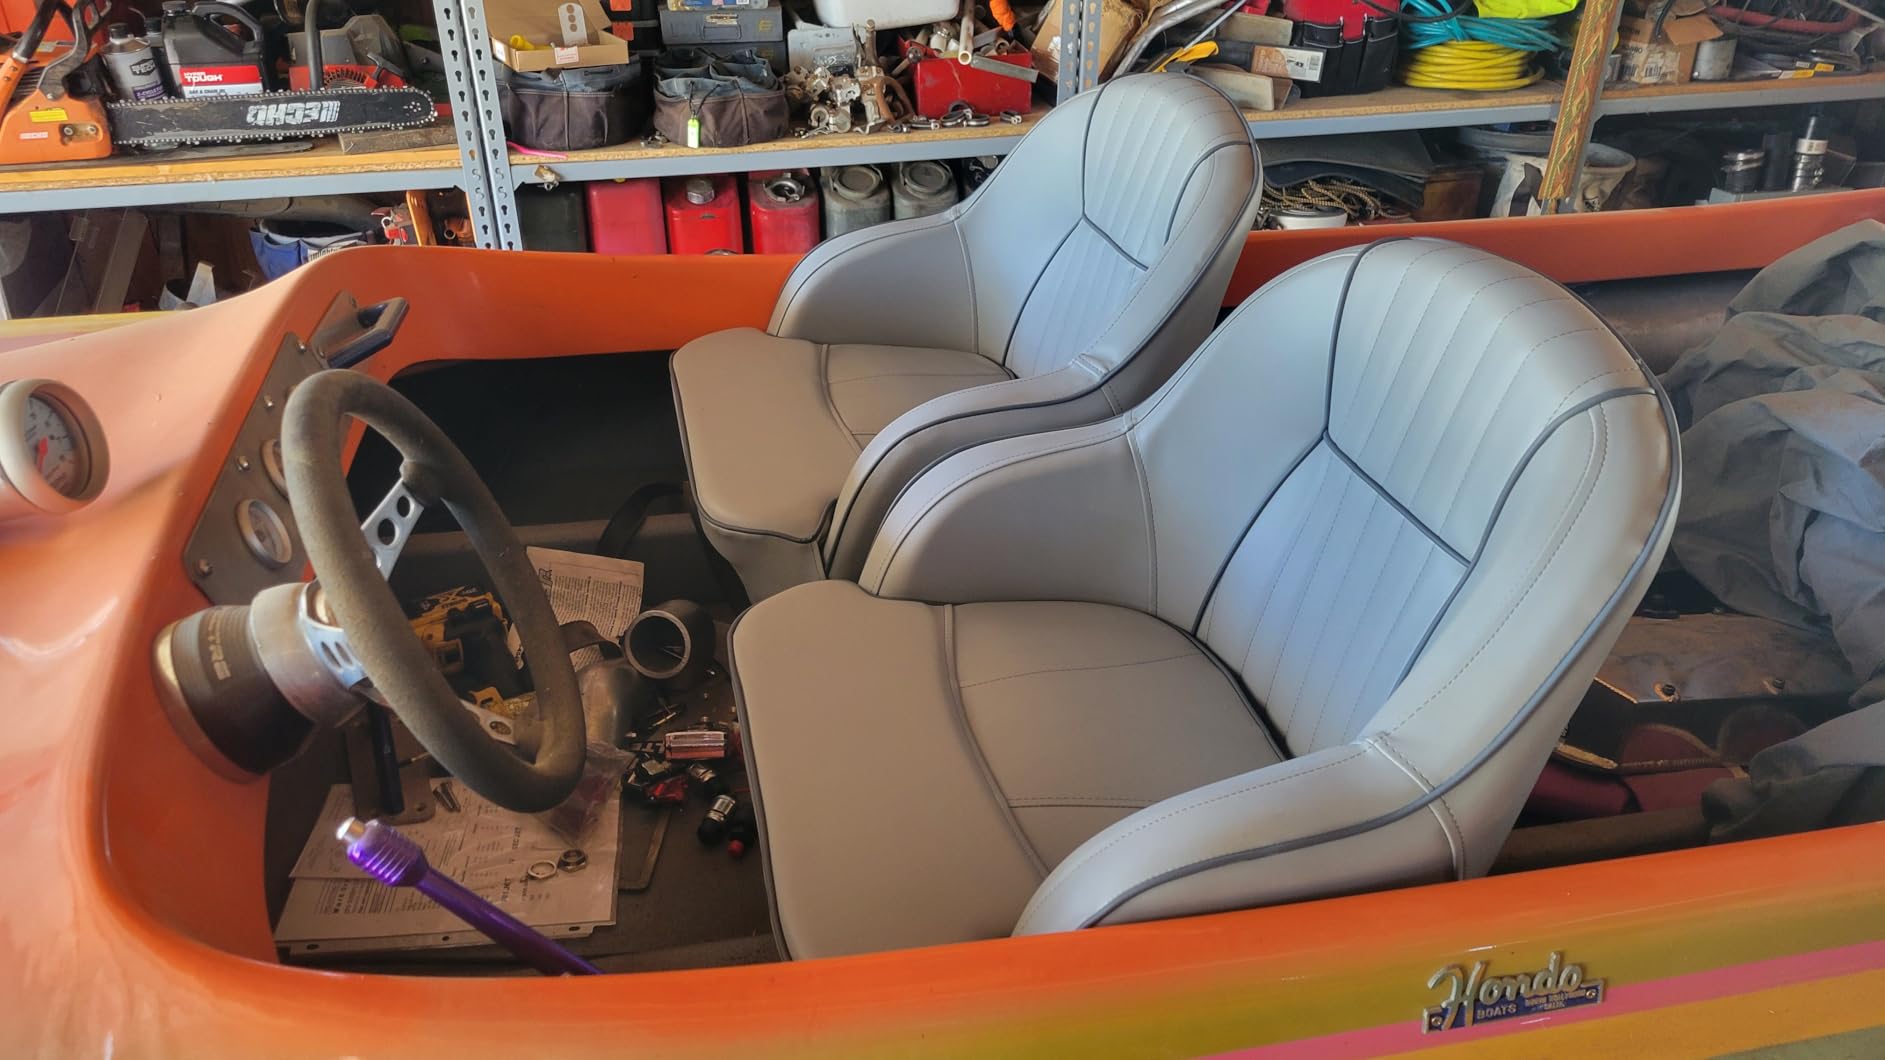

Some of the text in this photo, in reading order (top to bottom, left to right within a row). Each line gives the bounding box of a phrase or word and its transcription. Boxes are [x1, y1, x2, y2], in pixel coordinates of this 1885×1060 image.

[186, 74, 223, 83] TOUGH
[246, 101, 322, 126] ECHO
[1427, 951, 1583, 1031] Hondo
[1476, 1003, 1517, 1019] BOATS
